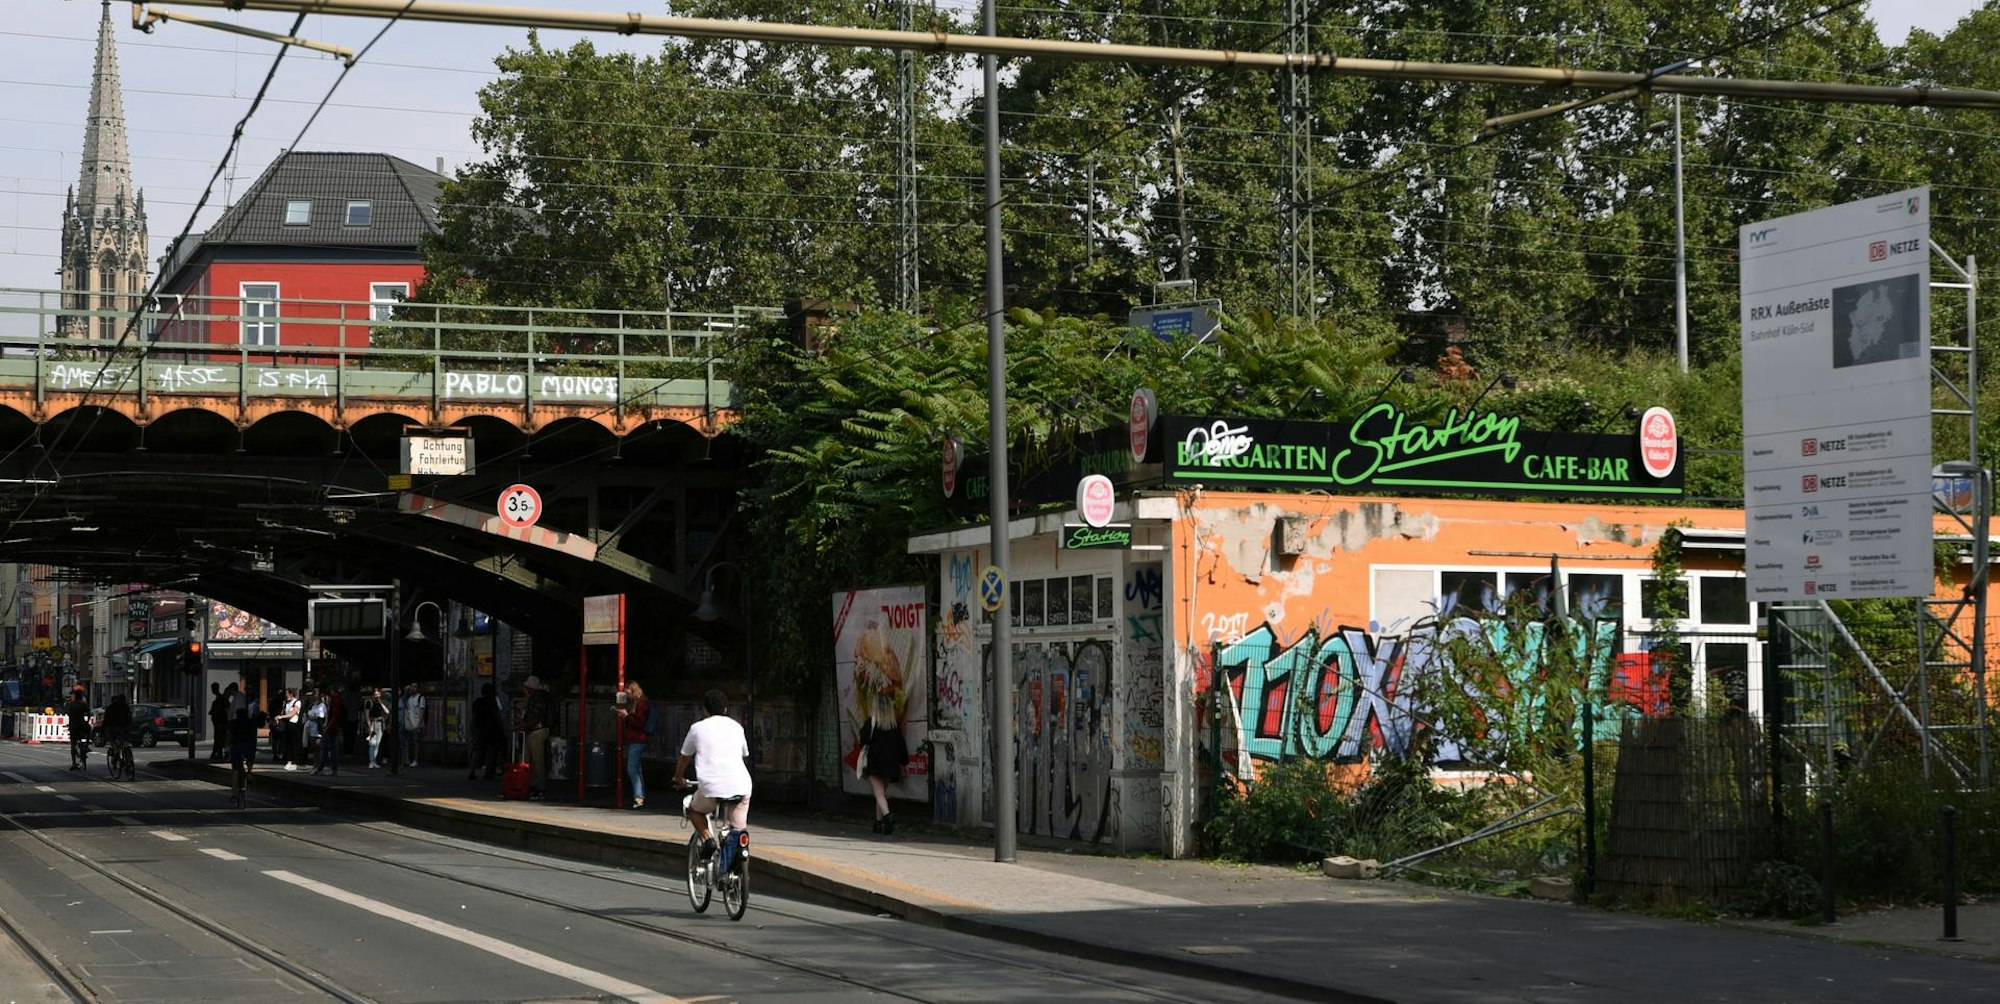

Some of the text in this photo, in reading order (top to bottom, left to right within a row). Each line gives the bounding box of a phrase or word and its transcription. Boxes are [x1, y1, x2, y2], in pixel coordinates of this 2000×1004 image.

[1870, 239, 1920, 259] DB NETZE
[1750, 297, 1831, 322] RRX Außenäste
[445, 372, 523, 398] PABLO
[423, 440, 462, 454] Achtung
[1332, 404, 1521, 485] Station
[1819, 440, 1846, 452] NETZE
[1523, 455, 1630, 482] CAFE-BAR
[1820, 477, 1846, 488] NETZE
[1066, 527, 1130, 549] Station
[1818, 584, 1837, 592] NETZE
[881, 603, 925, 630] VOIGT
